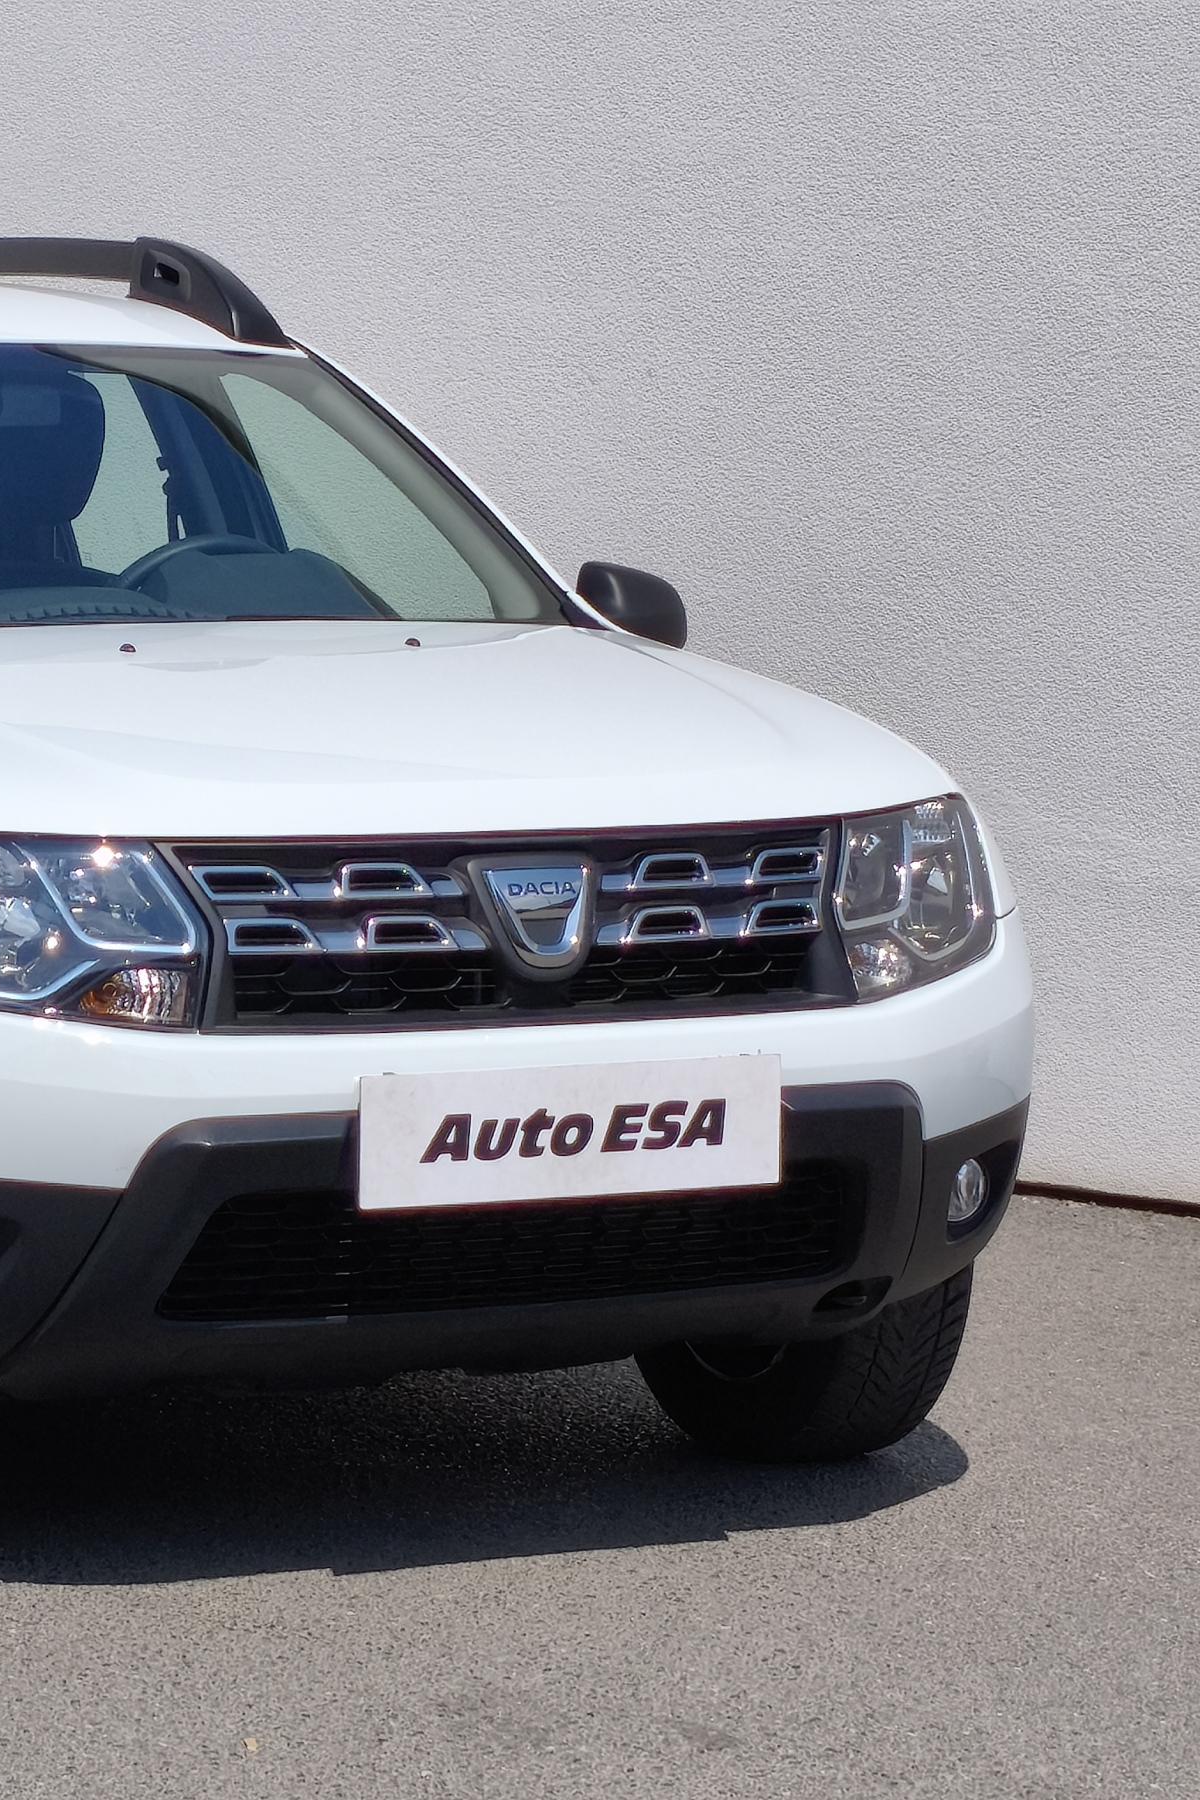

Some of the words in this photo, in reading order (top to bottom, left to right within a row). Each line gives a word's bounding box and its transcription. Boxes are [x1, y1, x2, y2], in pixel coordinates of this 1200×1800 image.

[507, 881, 577, 897] DACIA
[419, 1107, 594, 1164] Auto
[600, 1098, 727, 1153] ESA
